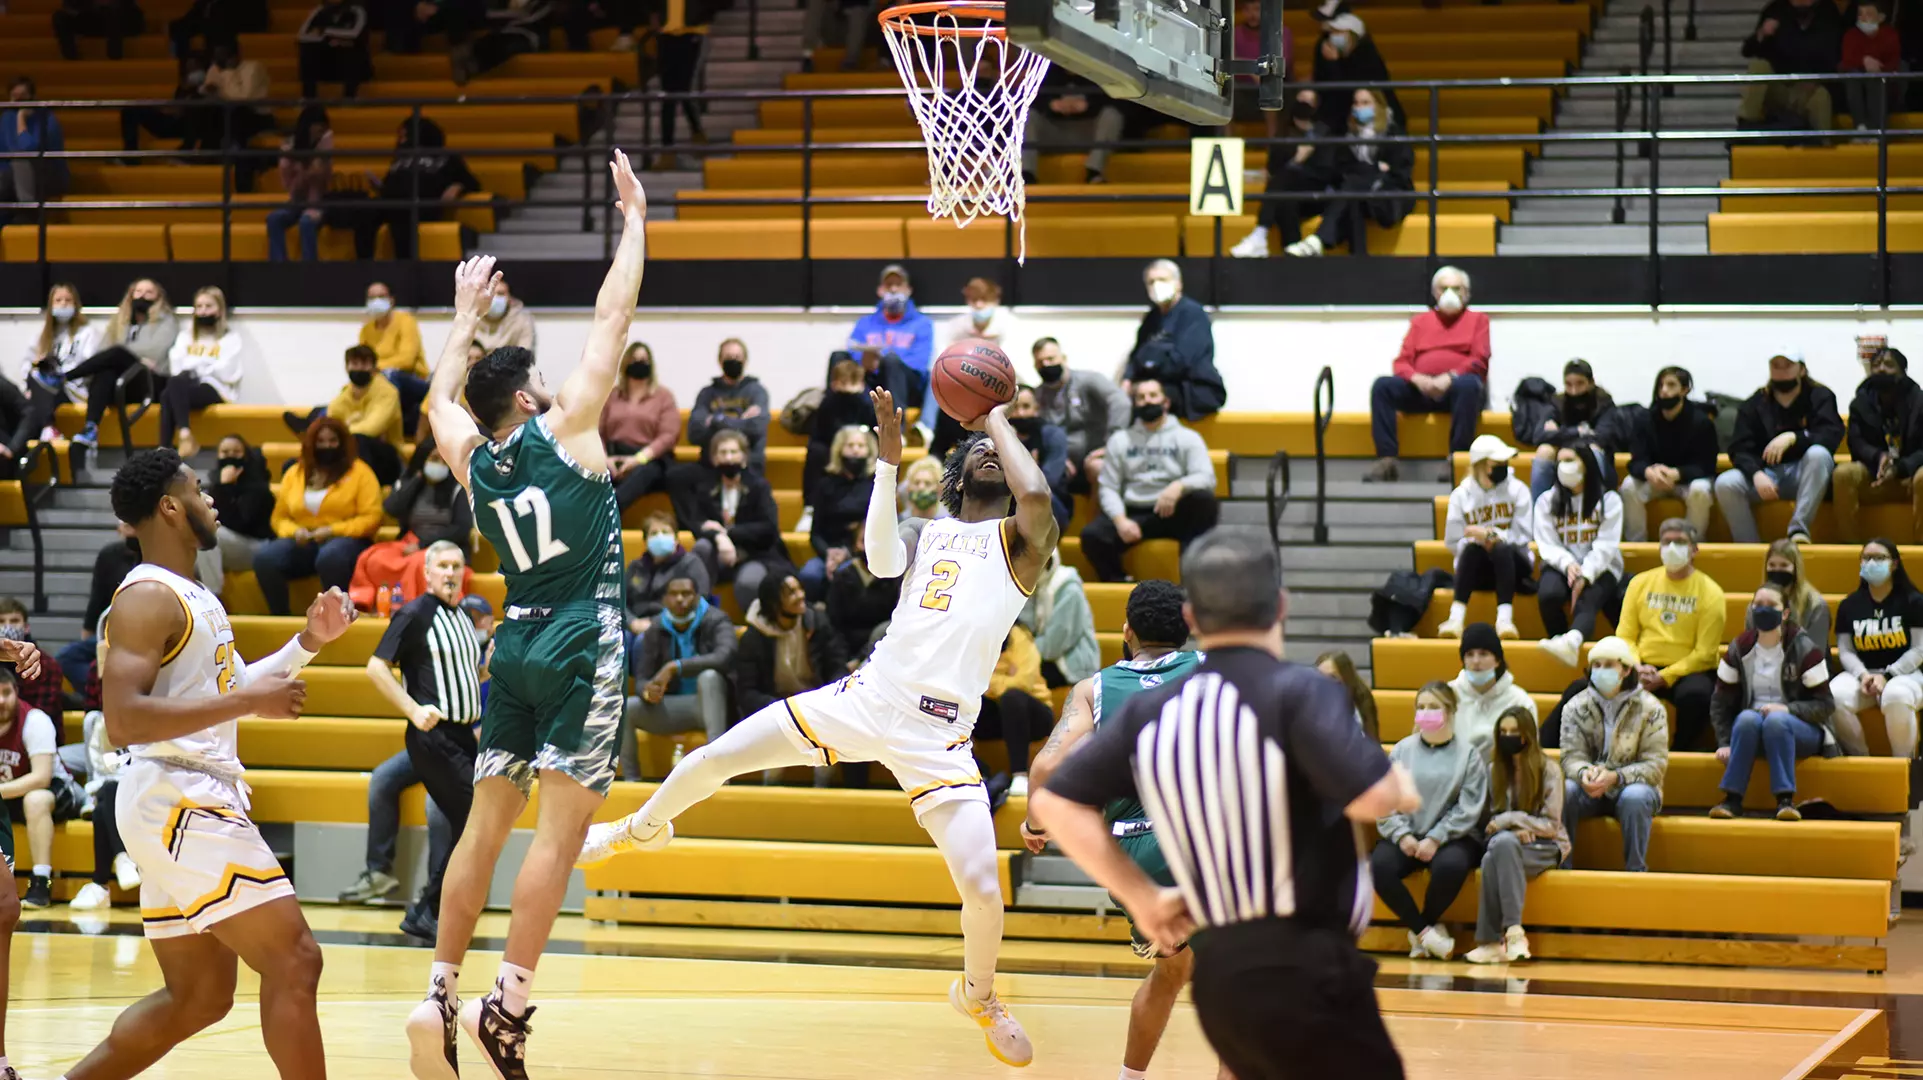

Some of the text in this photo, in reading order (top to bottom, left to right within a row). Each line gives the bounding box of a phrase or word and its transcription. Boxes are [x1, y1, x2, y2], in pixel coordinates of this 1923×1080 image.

[1198, 144, 1235, 211] A
[960, 359, 1009, 399] Wilson
[482, 485, 570, 573] 12
[923, 532, 991, 559] VILLE
[919, 559, 962, 612] 2
[1853, 615, 1902, 638] VILLE
[1853, 630, 1907, 652] NATION
